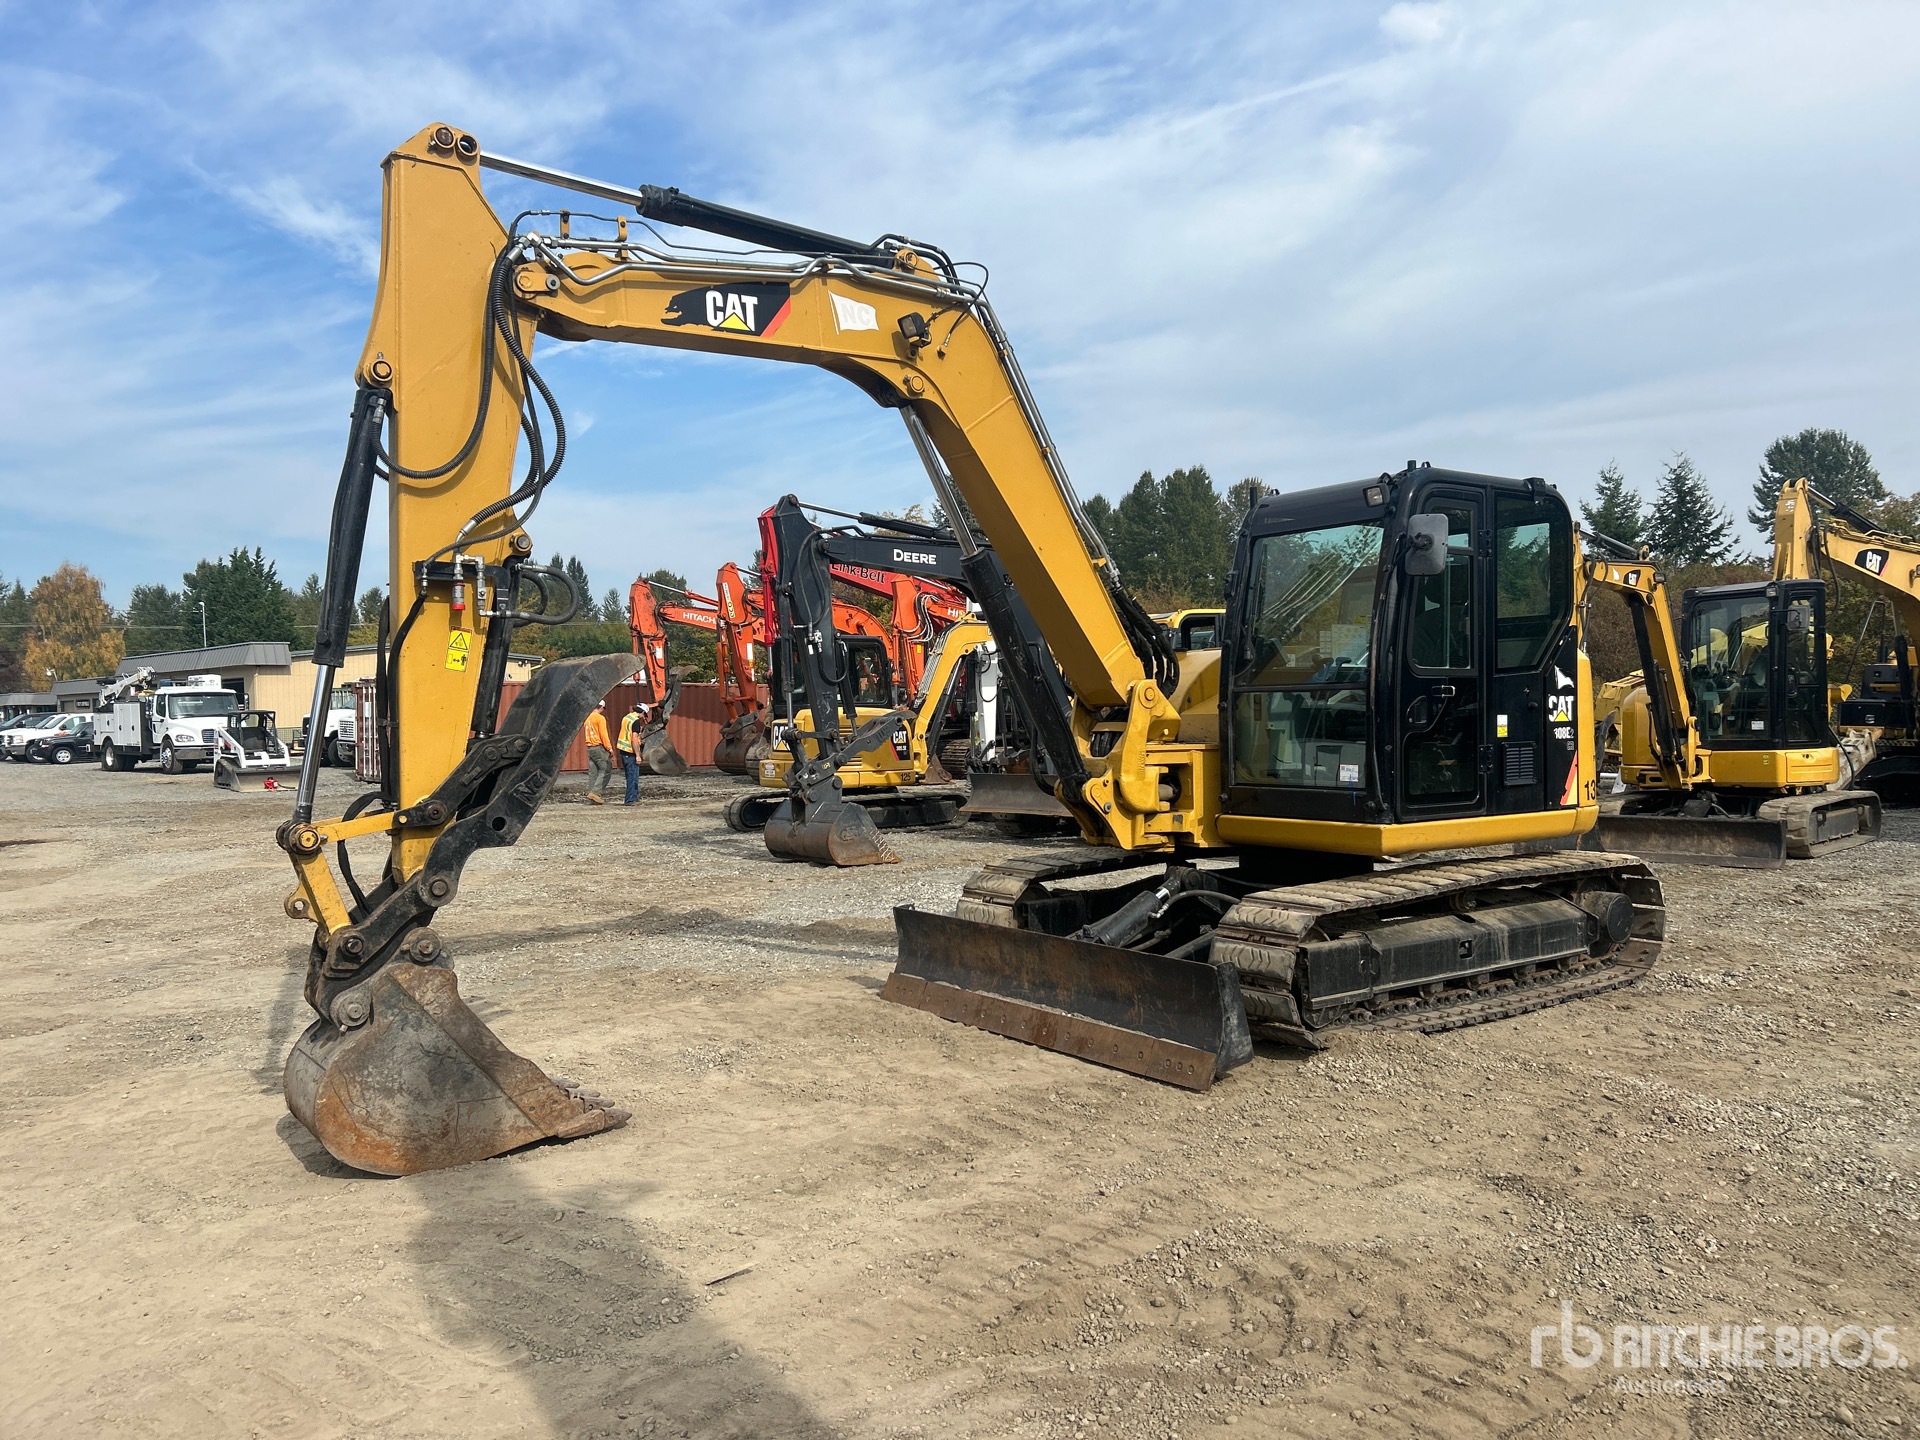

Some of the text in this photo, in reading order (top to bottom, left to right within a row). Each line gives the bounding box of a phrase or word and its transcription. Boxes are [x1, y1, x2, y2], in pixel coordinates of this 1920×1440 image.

[705, 290, 758, 332] CAT
[841, 302, 871, 325] NC
[893, 548, 937, 565] DEERE
[1866, 551, 1882, 573] CAT
[947, 607, 959, 618] HI
[1548, 695, 1574, 722] CAT
[893, 731, 907, 744] CAT
[900, 772, 911, 782] 125
